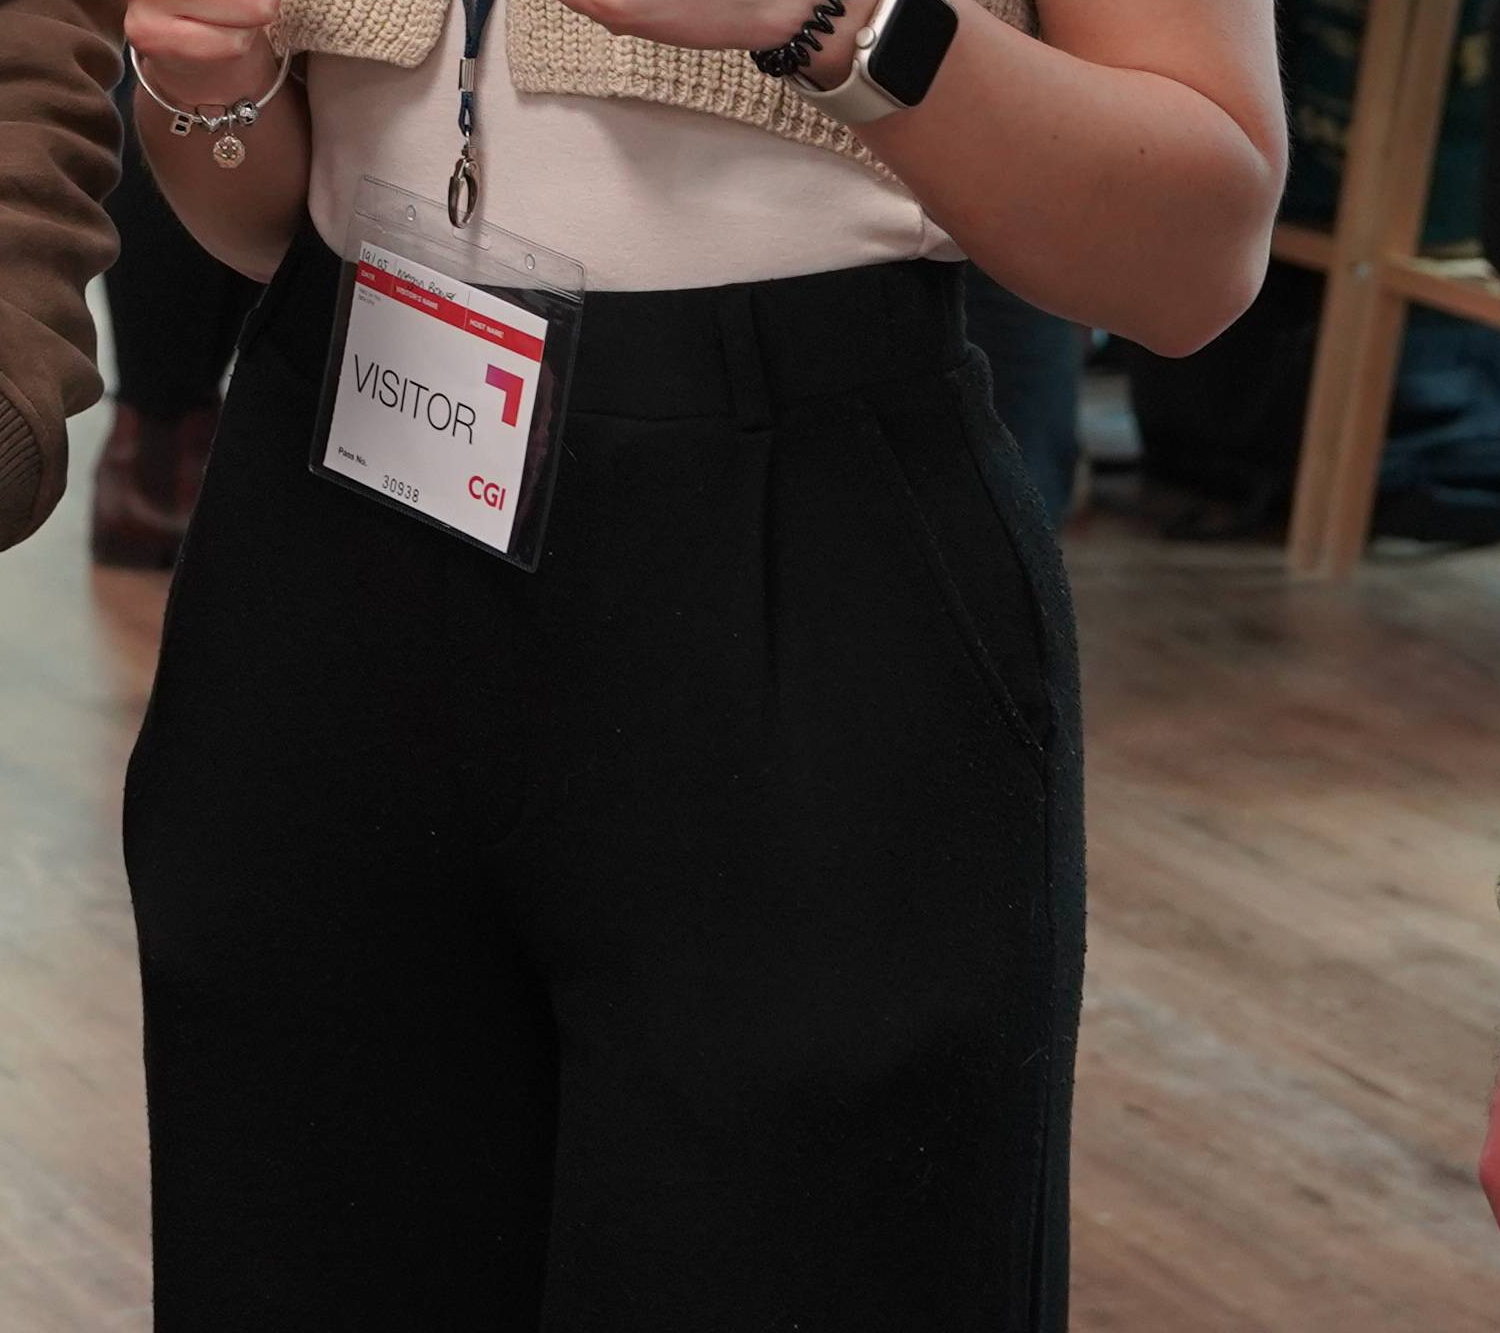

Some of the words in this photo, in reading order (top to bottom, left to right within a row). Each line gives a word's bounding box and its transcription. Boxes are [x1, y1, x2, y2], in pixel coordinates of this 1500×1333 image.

[354, 354, 476, 445] VISITOR
[338, 446, 354, 461] Pass
[355, 454, 368, 467] No.
[382, 475, 420, 504] 30938
[467, 475, 506, 511] CGI
